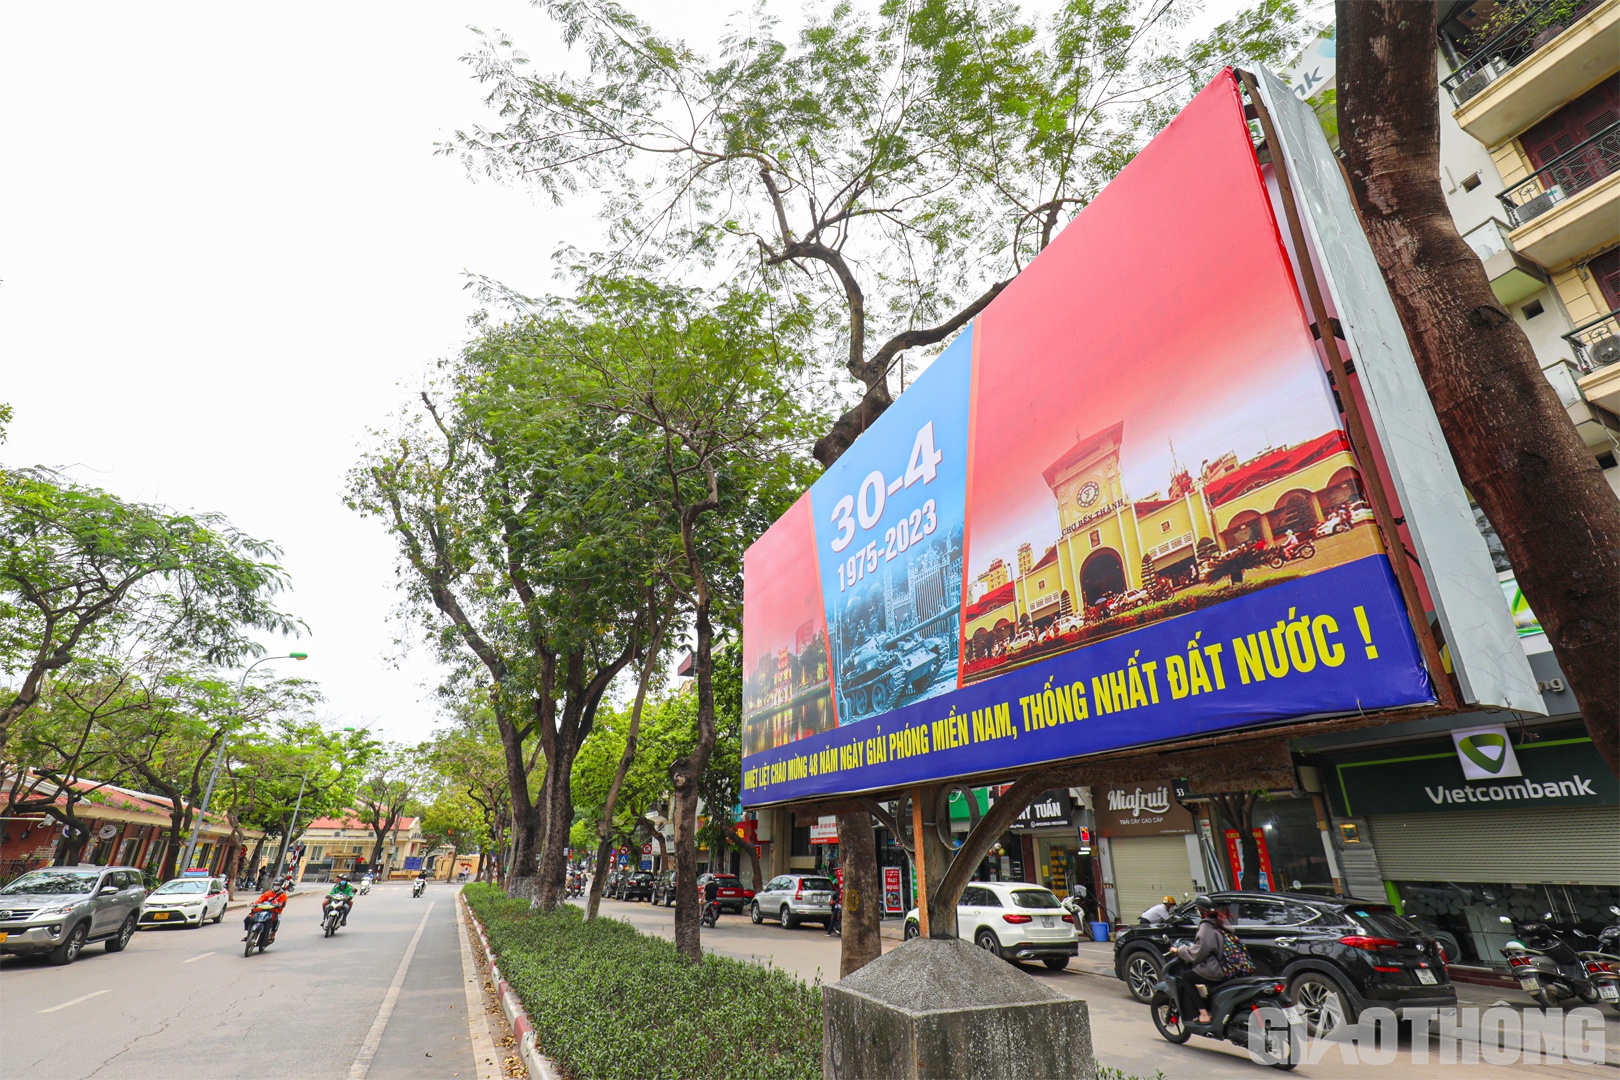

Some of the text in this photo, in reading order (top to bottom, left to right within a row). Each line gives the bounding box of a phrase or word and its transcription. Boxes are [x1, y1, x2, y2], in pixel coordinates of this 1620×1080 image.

[830, 420, 943, 553] 30-4
[836, 498, 938, 593] 1975-2023
[743, 605, 1380, 793] NHIỆT LIỆT CHÀO MỪNG 48 NĂM NGÀY GIẢI PHÓNG MIỀN NAM, THỐNG NHẤT ĐẤT NƯỚC !
[1107, 786, 1170, 817] Miafruit
[1176, 788, 1185, 797] 53
[1425, 775, 1597, 805] Vietcombank
[1034, 798, 1062, 819] TUẤN
